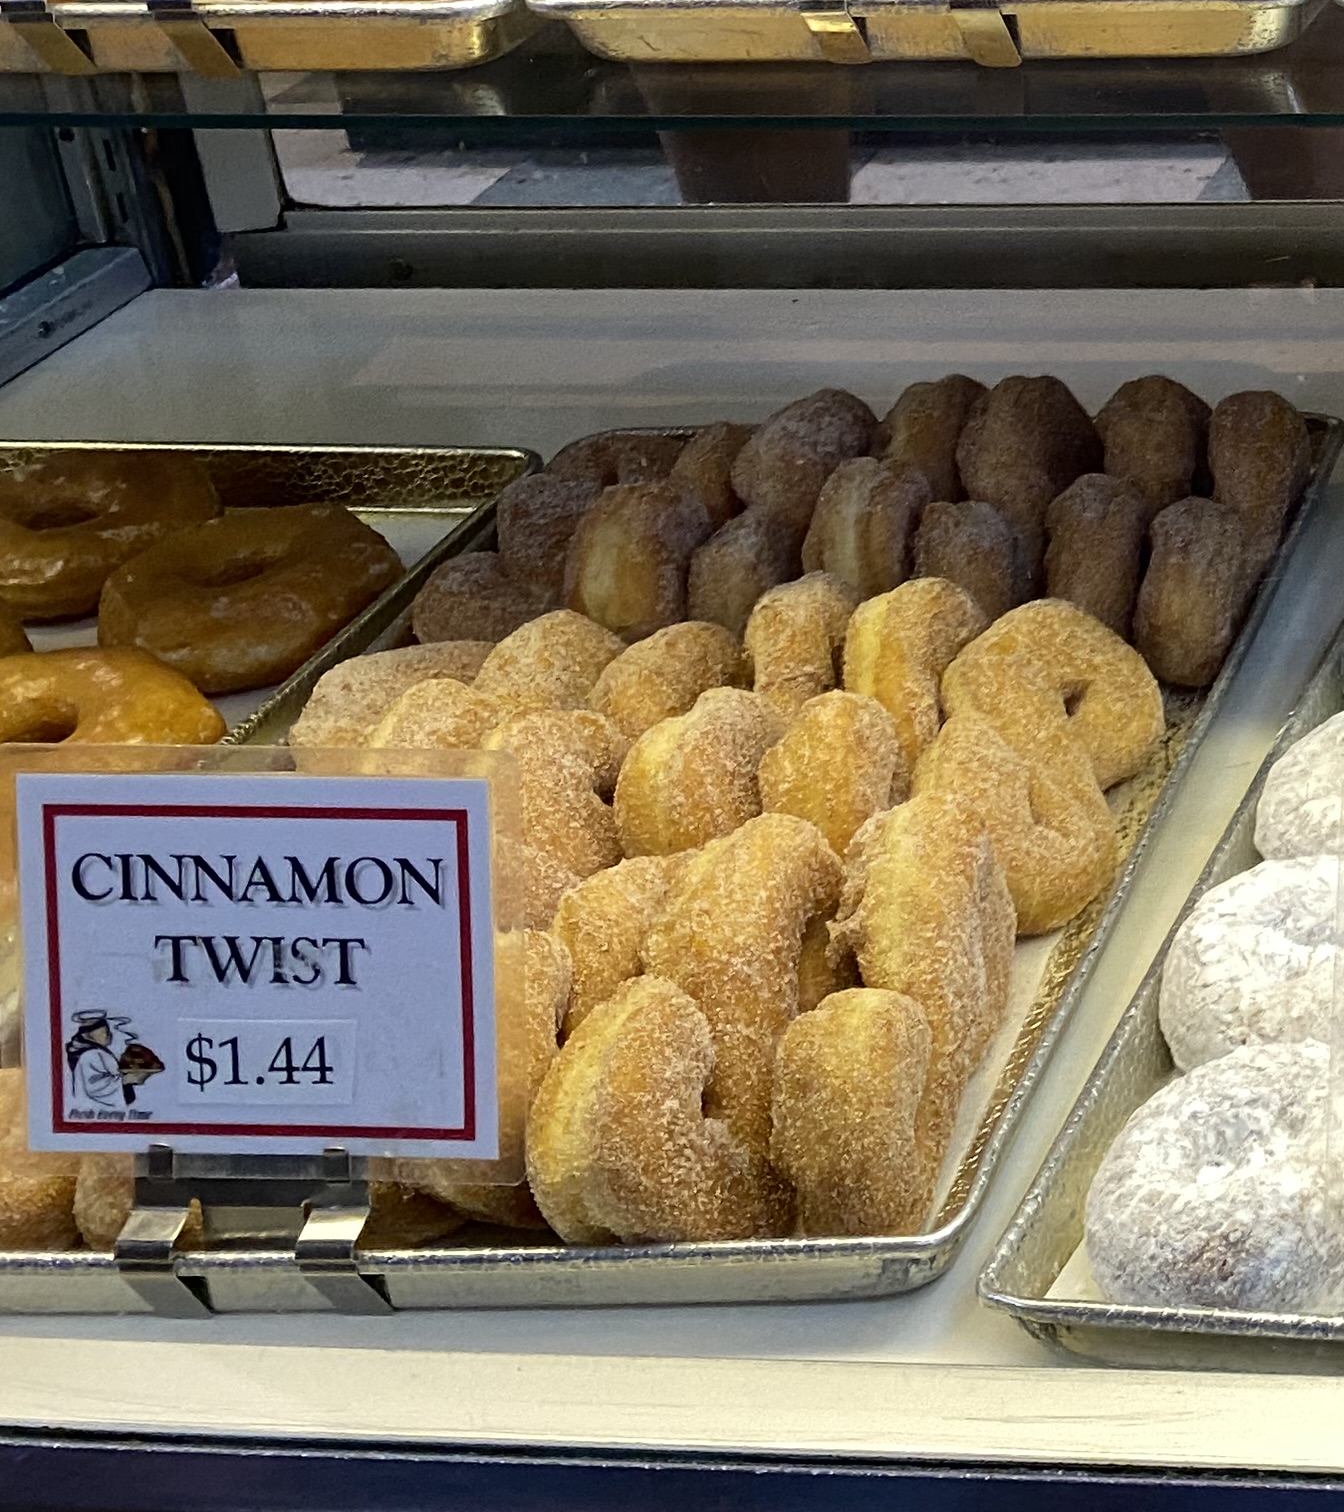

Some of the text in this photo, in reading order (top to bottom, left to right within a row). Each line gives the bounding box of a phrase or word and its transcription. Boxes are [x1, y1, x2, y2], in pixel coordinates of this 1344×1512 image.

[71, 852, 443, 905] CINNAMON
[155, 935, 365, 986] TWIST
[185, 1032, 334, 1092] $1.44
